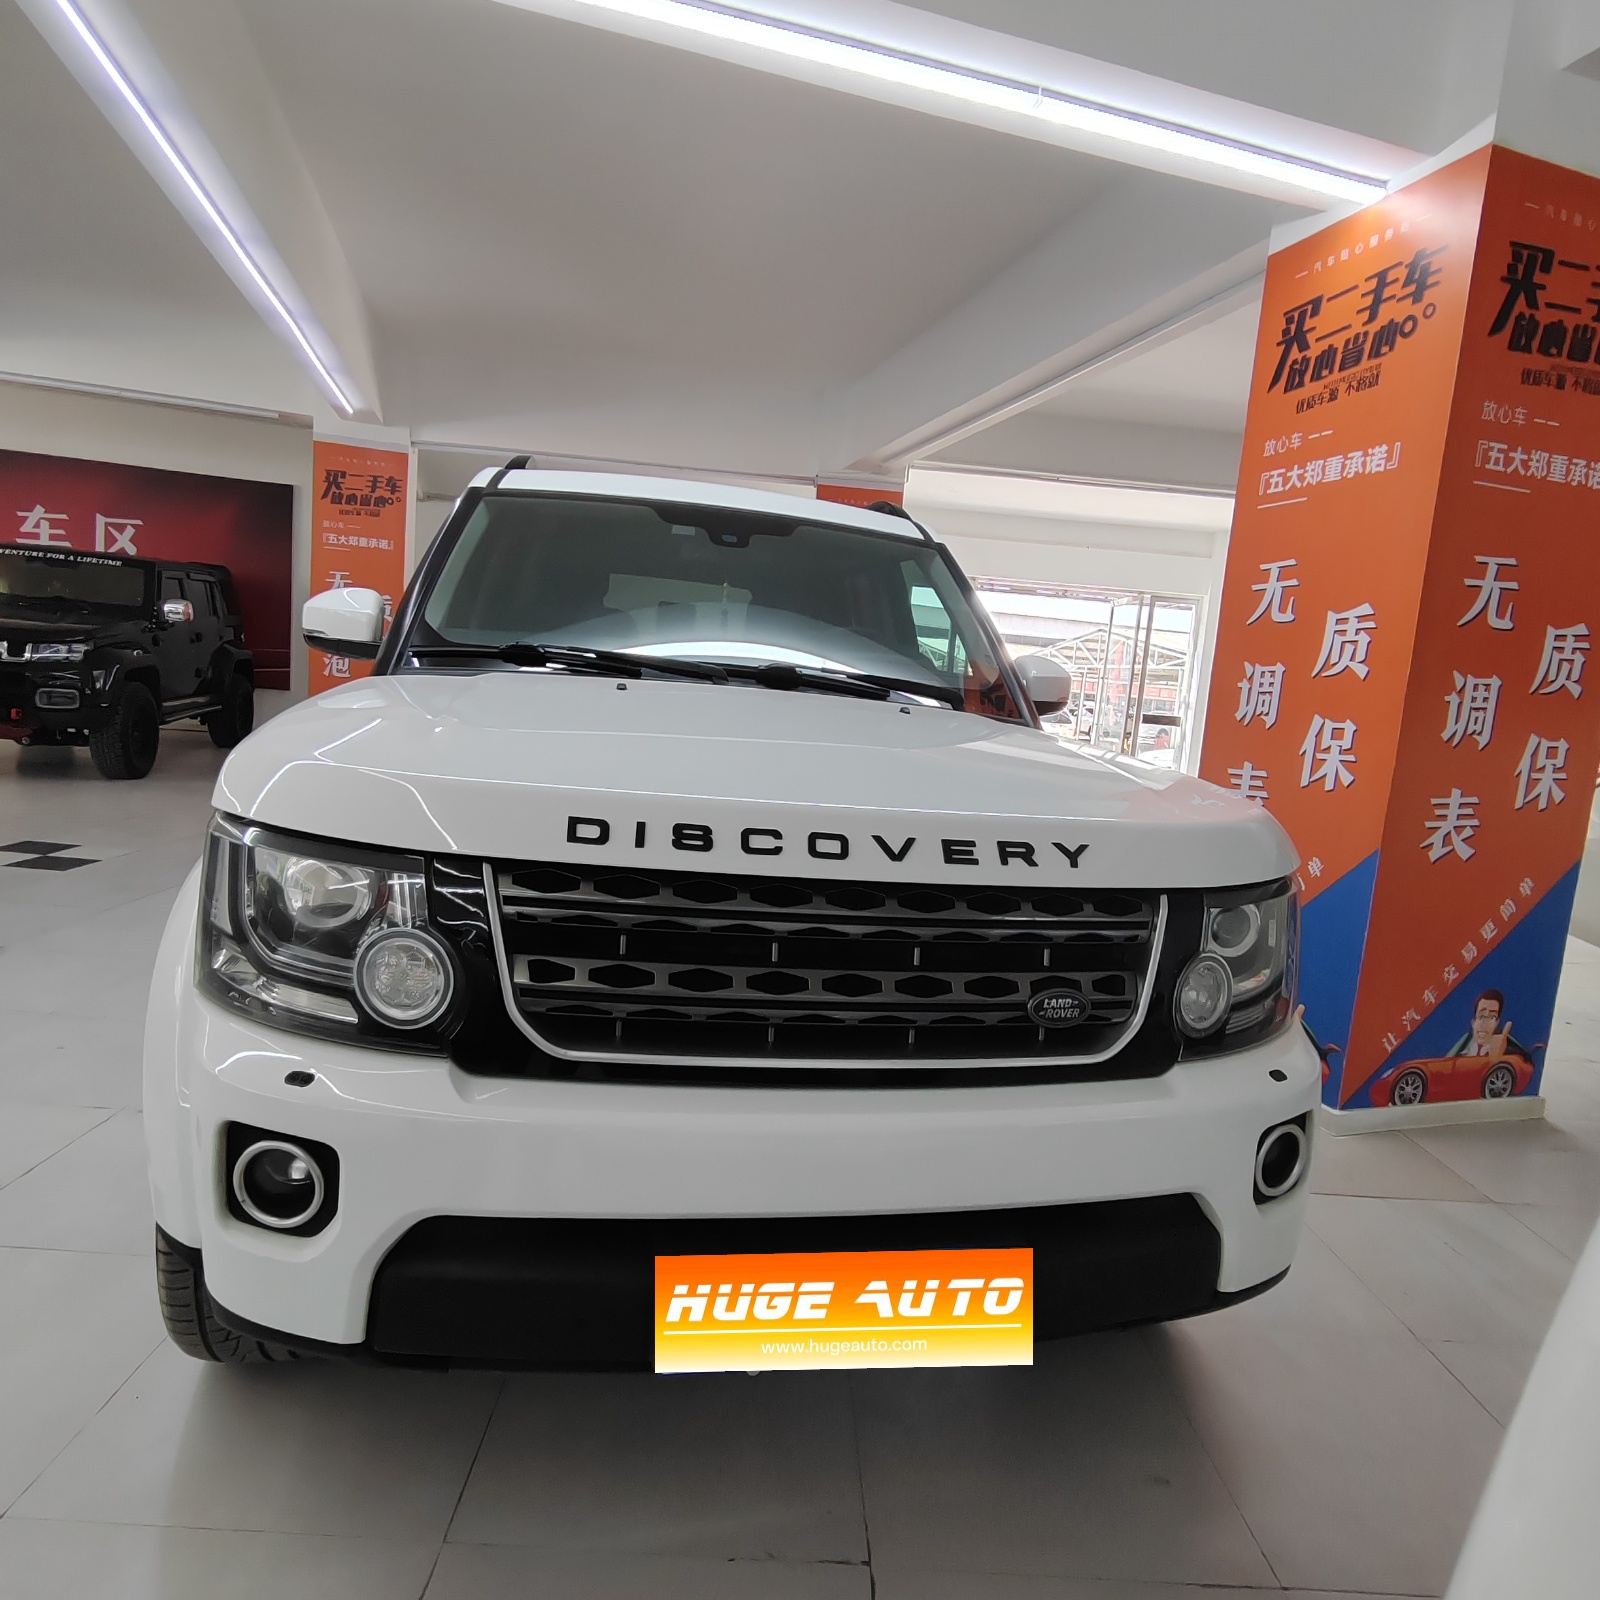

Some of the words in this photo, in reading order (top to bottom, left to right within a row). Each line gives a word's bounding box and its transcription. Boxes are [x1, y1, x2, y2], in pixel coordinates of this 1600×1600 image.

[1487, 240, 1600, 338] 买二
[1267, 244, 1449, 394] 买二手车
[1263, 432, 1304, 457] 放心车
[321, 468, 403, 500] 买二手车
[46, 552, 65, 560] FOR
[77, 556, 122, 567] LIFETIME
[1299, 602, 1378, 792] 质保
[1513, 623, 1591, 812] 质保
[567, 815, 1090, 869] DISCOVERY
[1043, 998, 1073, 1008] LAND
[1045, 1008, 1080, 1018] ROVER
